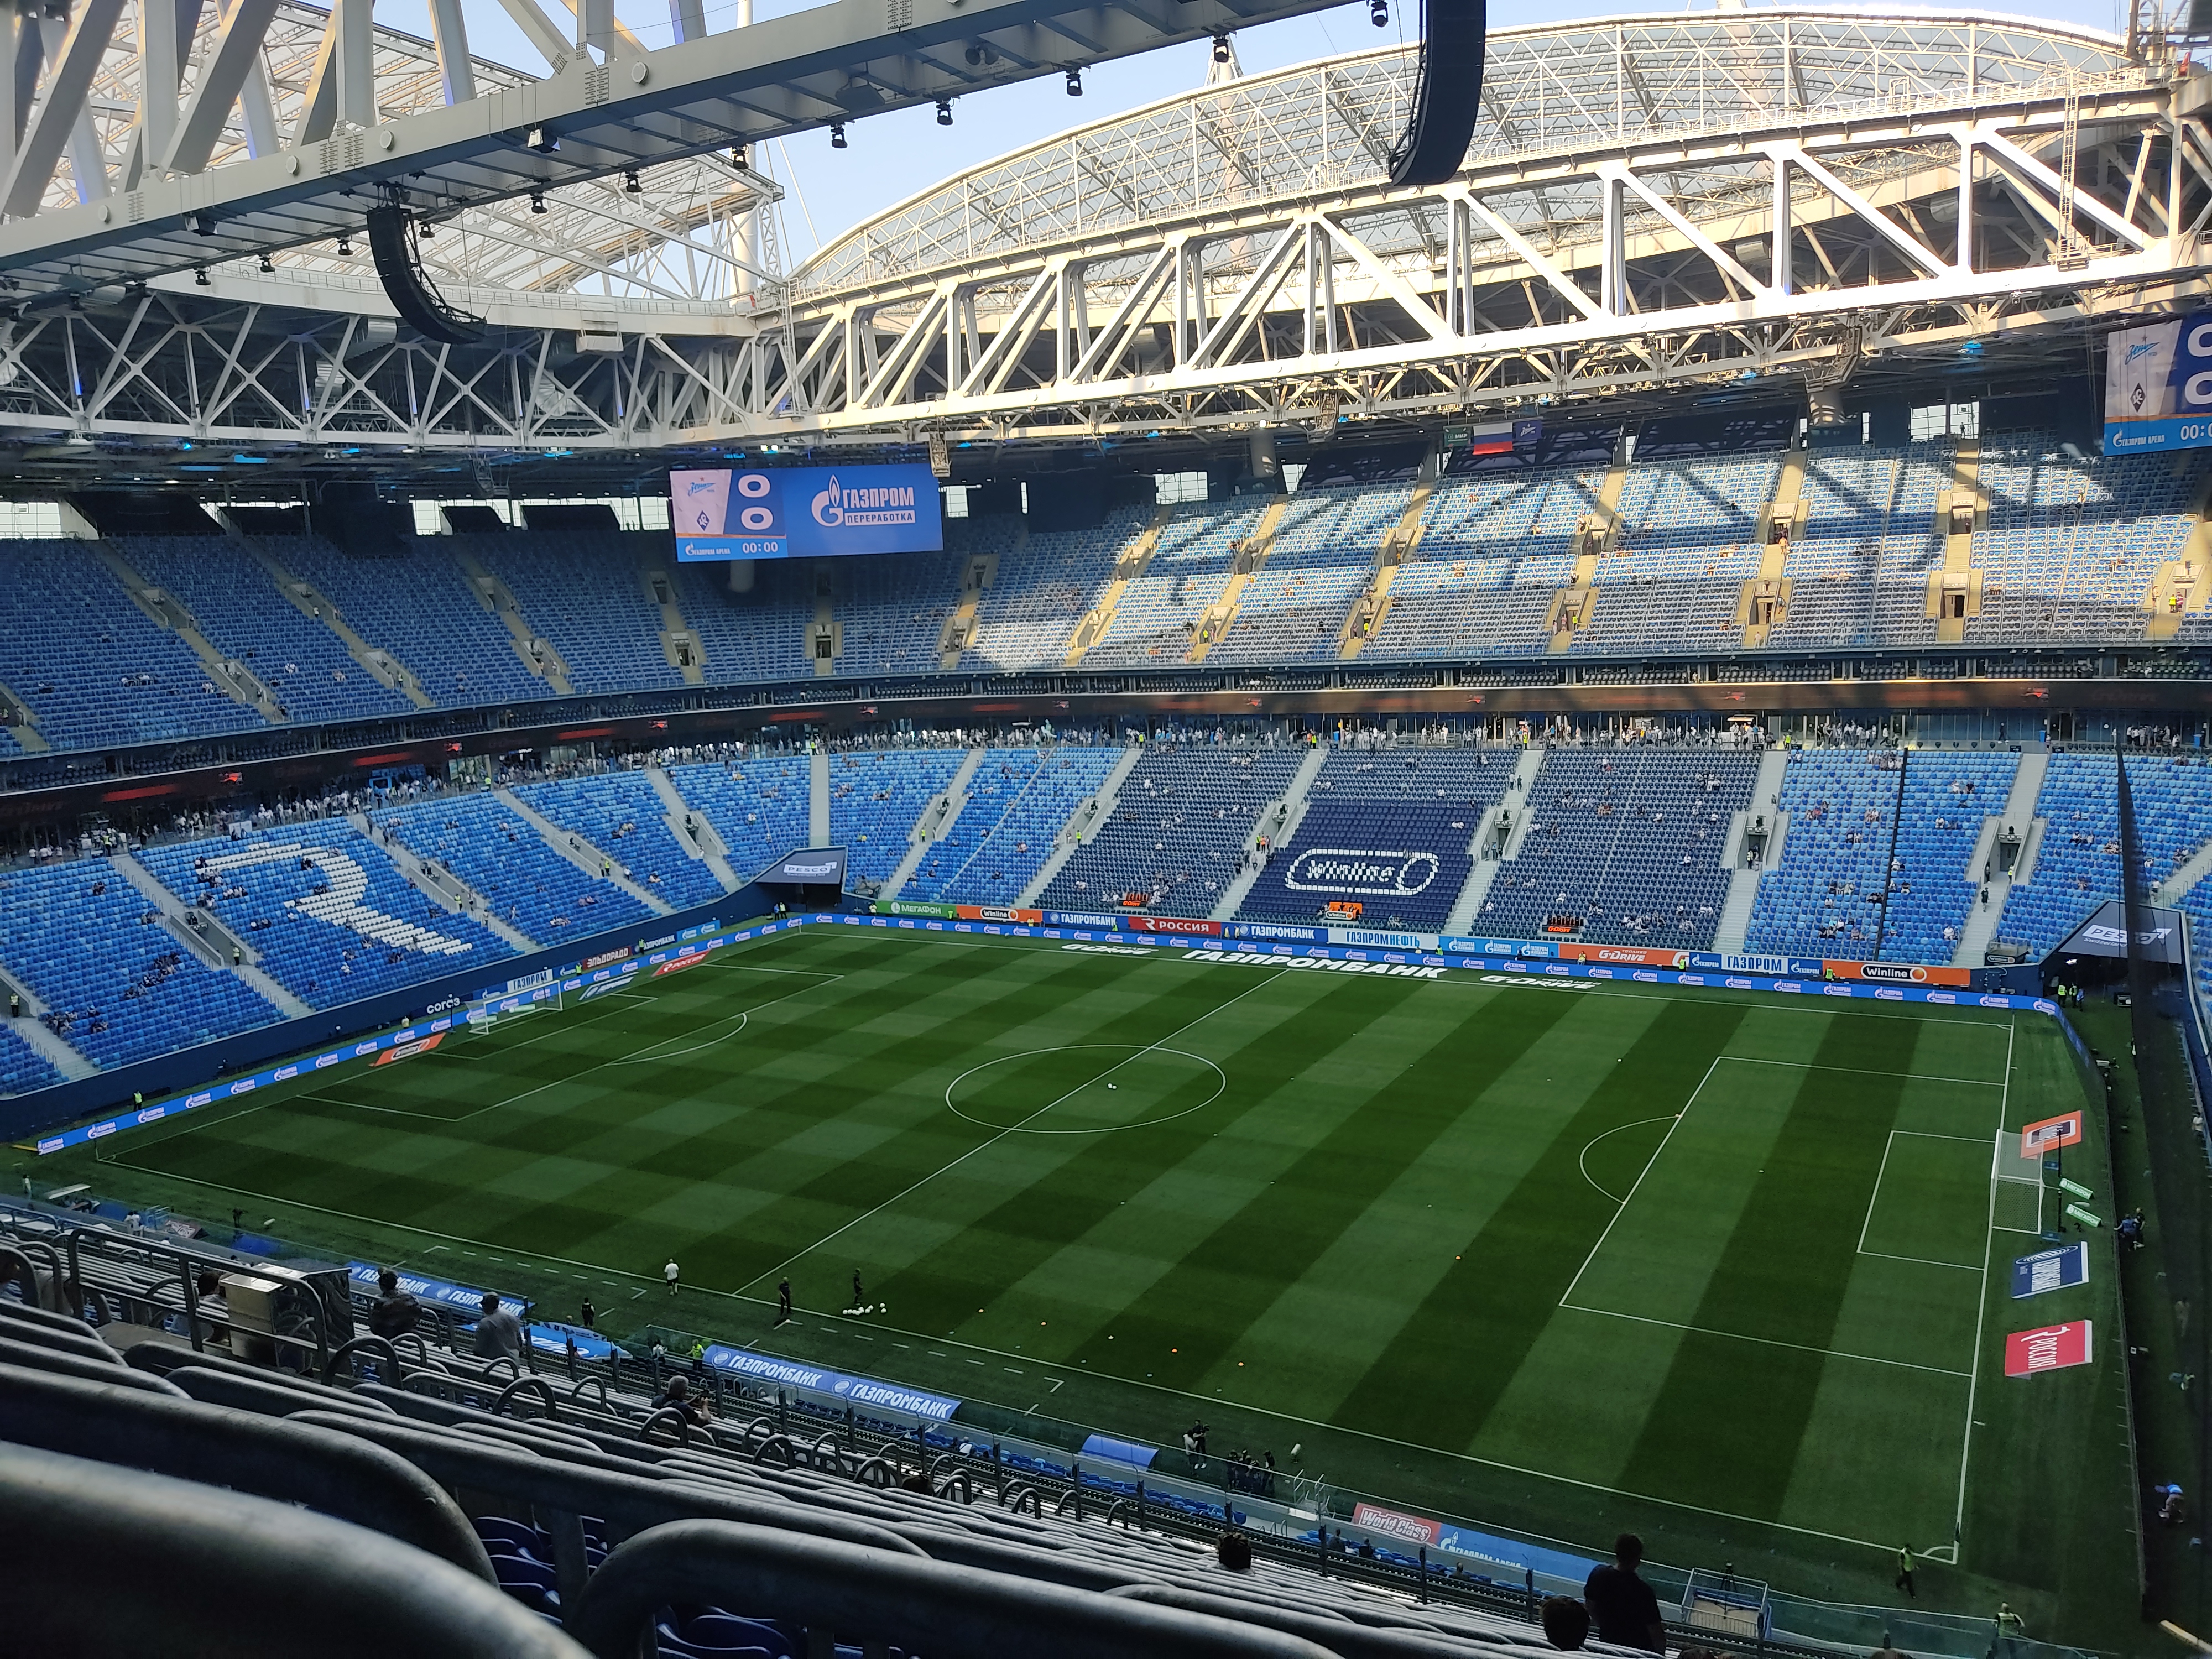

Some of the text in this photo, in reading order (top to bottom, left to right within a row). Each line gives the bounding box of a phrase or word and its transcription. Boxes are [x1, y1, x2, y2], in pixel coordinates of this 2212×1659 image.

[842, 487, 915, 509] ГАЗПРОМ
[847, 512, 913, 524] ПЕРЕРАБОТКА
[742, 541, 778, 554] 00:00
[983, 910, 1007, 918] Winline
[1061, 913, 1117, 926] ГАЗПРОМБАНК
[1159, 921, 1209, 932] РОССИЯ
[1251, 926, 1316, 940] ГАЗПРОМБАНК
[641, 935, 675, 950] АЗПРОМБАНК
[1346, 931, 1420, 947] ГАЗПРОМНЕФТЬ
[2090, 928, 2151, 942] PESO
[587, 947, 629, 968] ЭЛЬДОРАДО
[1181, 950, 1448, 978] ГАЗПРОМБАНК
[1727, 956, 1782, 972] ГАЗПРОМ
[1866, 967, 1908, 978] Winline
[513, 972, 547, 990] ГАЗПРОМ
[426, 997, 461, 1014] согаз
[448, 1290, 525, 1317] ГАЗПРБАНК
[728, 1355, 822, 1388] ГАЗПРОМБАНК
[850, 1384, 952, 1419] ГАЗПРОМБАНК
[1361, 1509, 1430, 1542] World Class
